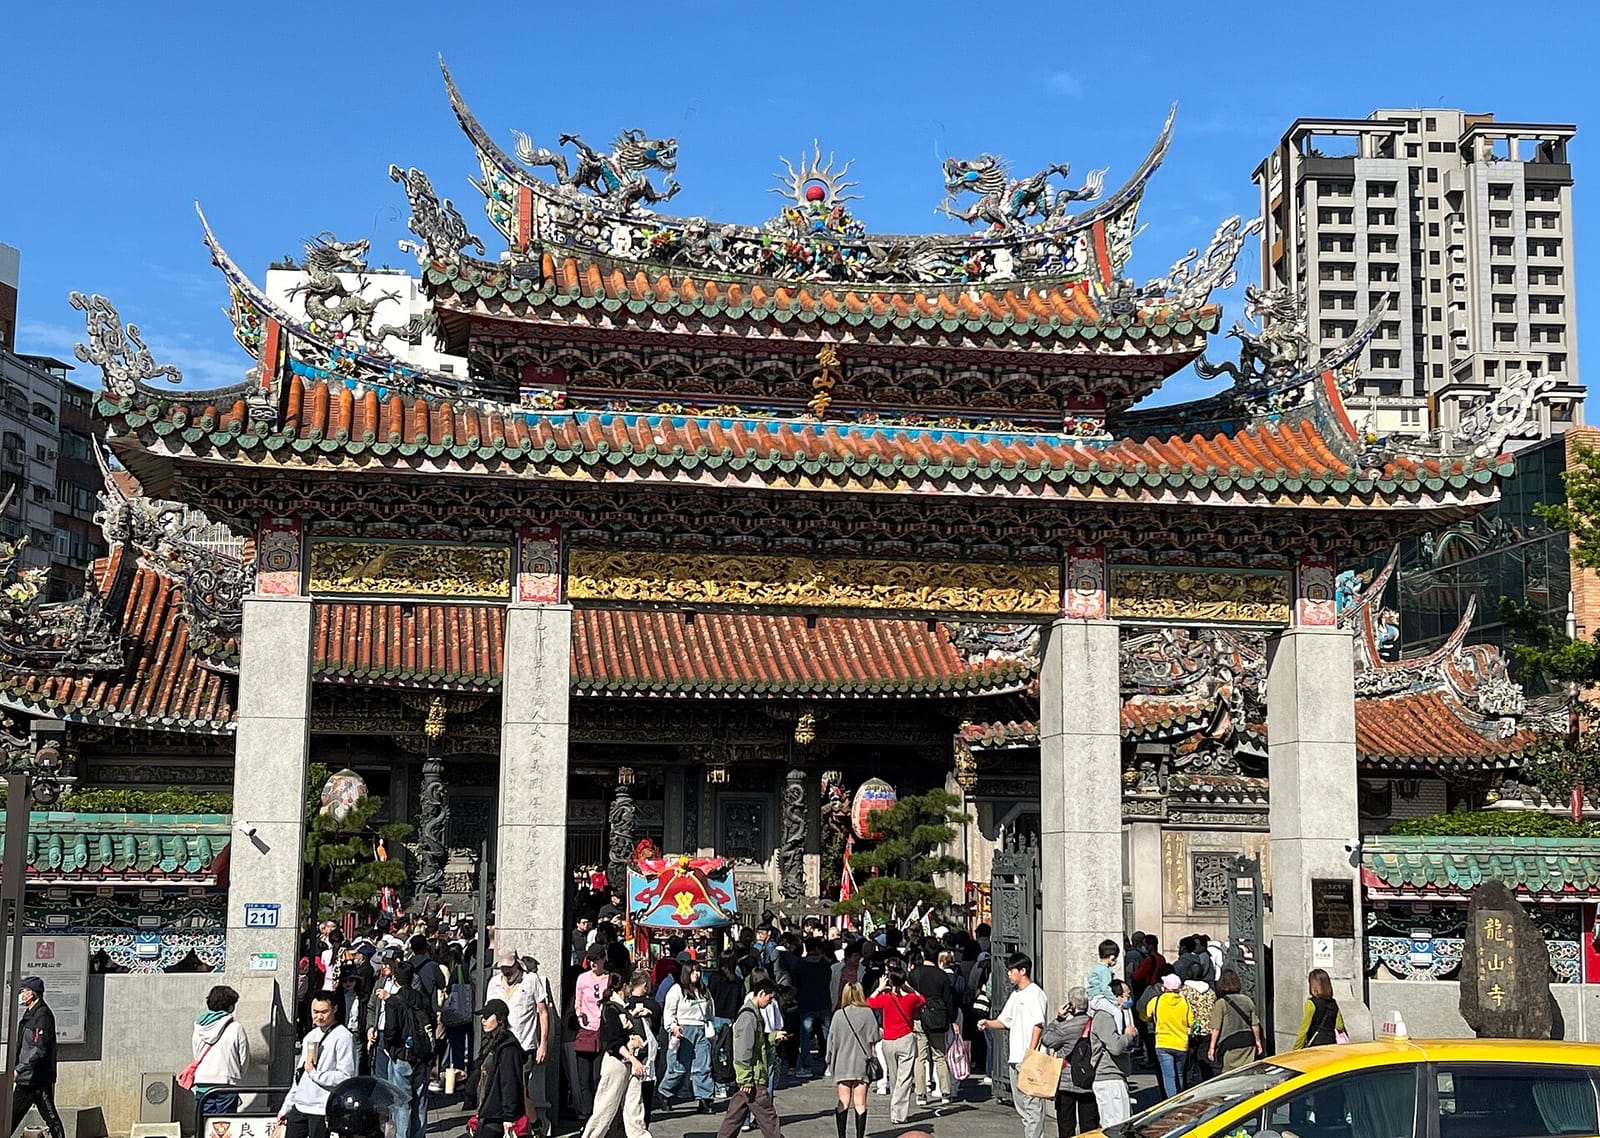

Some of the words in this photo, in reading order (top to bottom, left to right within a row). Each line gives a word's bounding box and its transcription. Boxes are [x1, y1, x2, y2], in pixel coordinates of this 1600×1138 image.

[807, 343, 841, 418] 龍山寺
[250, 912, 274, 924] 211
[1484, 918, 1505, 1007] 龍山寺
